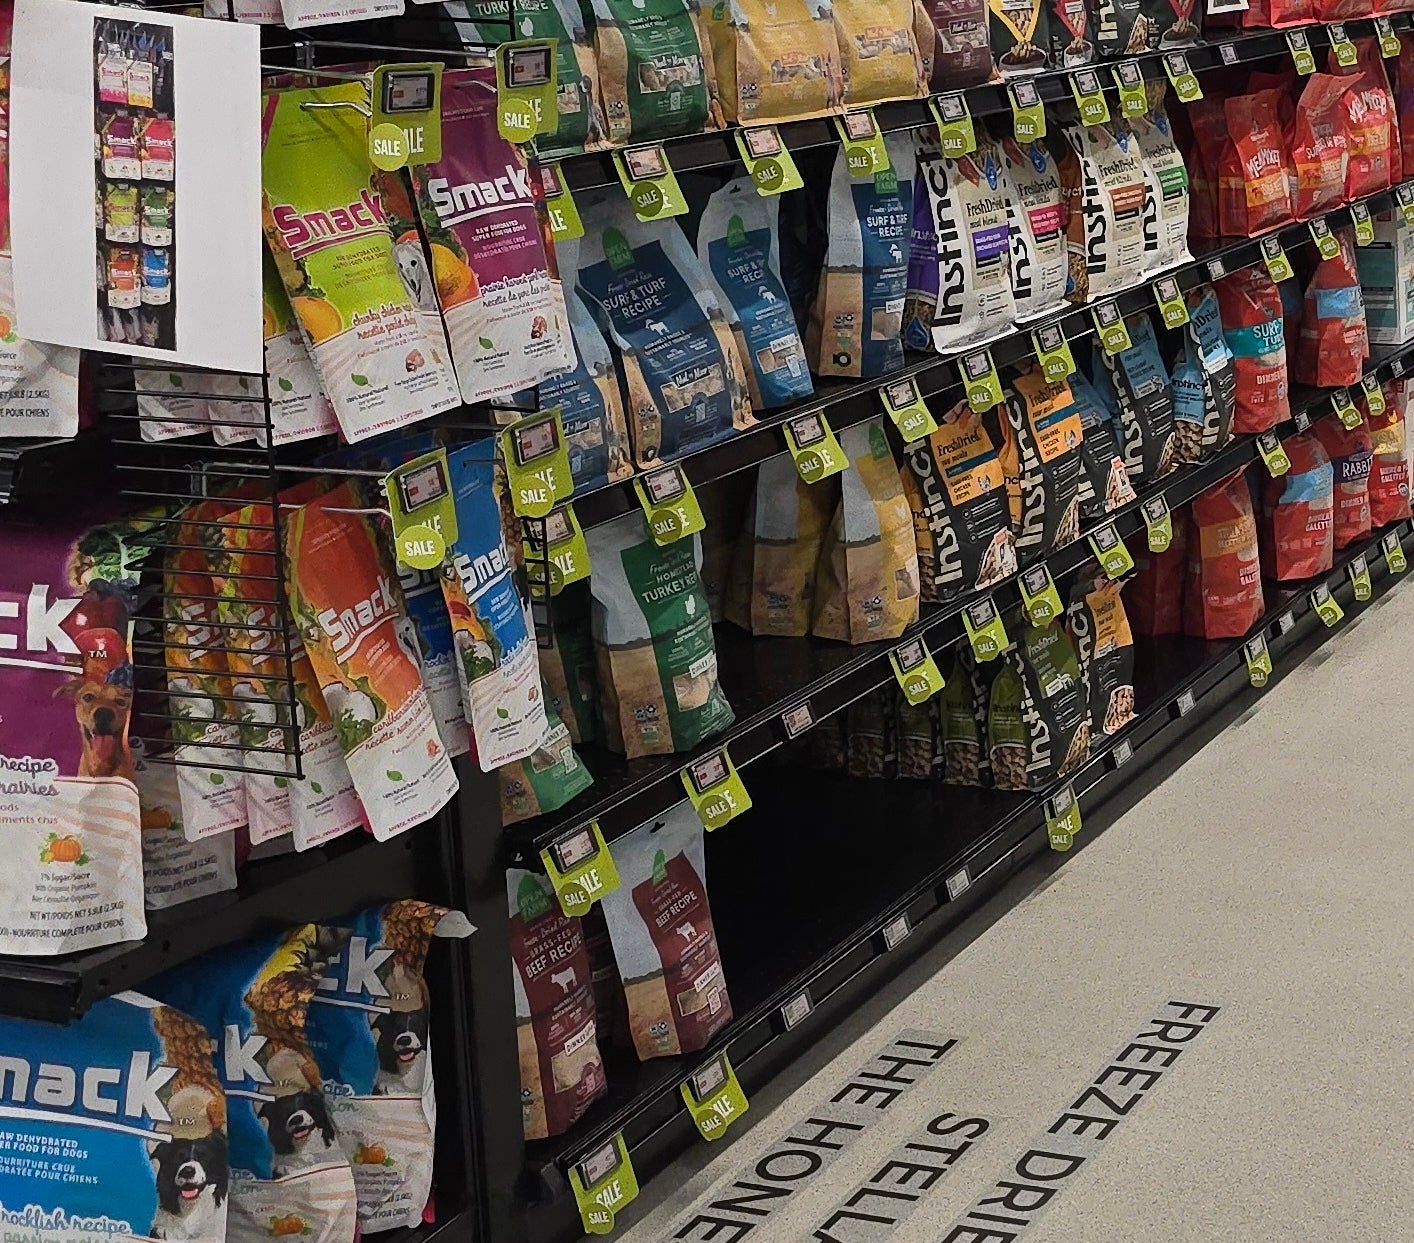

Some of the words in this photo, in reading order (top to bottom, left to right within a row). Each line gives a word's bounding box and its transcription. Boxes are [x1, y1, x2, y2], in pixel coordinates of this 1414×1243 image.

[503, 112, 531, 129] SALE
[374, 139, 401, 157] SALE
[848, 155, 868, 169] SALE
[756, 167, 779, 182] SALE
[428, 164, 533, 217] Smack
[636, 189, 659, 207] SALE
[272, 189, 387, 248] Smack
[641, 277, 667, 297] TURF
[622, 295, 662, 319] RECIPE
[903, 413, 925, 430] SALE
[937, 430, 981, 458] FreshDried
[800, 456, 820, 473] SALE
[520, 488, 548, 505] SALE
[654, 518, 677, 536] SALE
[404, 540, 435, 557] SALE
[642, 578, 686, 603] TURKEY
[318, 575, 397, 653] Smack
[0, 758, 56, 779] recipe
[706, 800, 727, 818] SALE
[564, 889, 586, 906] SALE
[525, 957, 548, 979] BEEF
[830, 1038, 959, 1112] THE
[1048, 1001, 1221, 1141] FREEZE
[700, 1115, 722, 1132] SALE
[17, 1133, 78, 1149] DEHYDRATED
[13, 1143, 39, 1154] FOOD
[41, 1145, 60, 1156] FOR
[63, 1148, 89, 1159] DOGS
[51, 1162, 76, 1173] CRUE
[35, 1169, 61, 1181] POUR
[63, 1173, 98, 1185] CHIENS
[1, 1204, 68, 1231] rockfish
[72, 1218, 130, 1239] recipe
[588, 1210, 610, 1226] SALE
